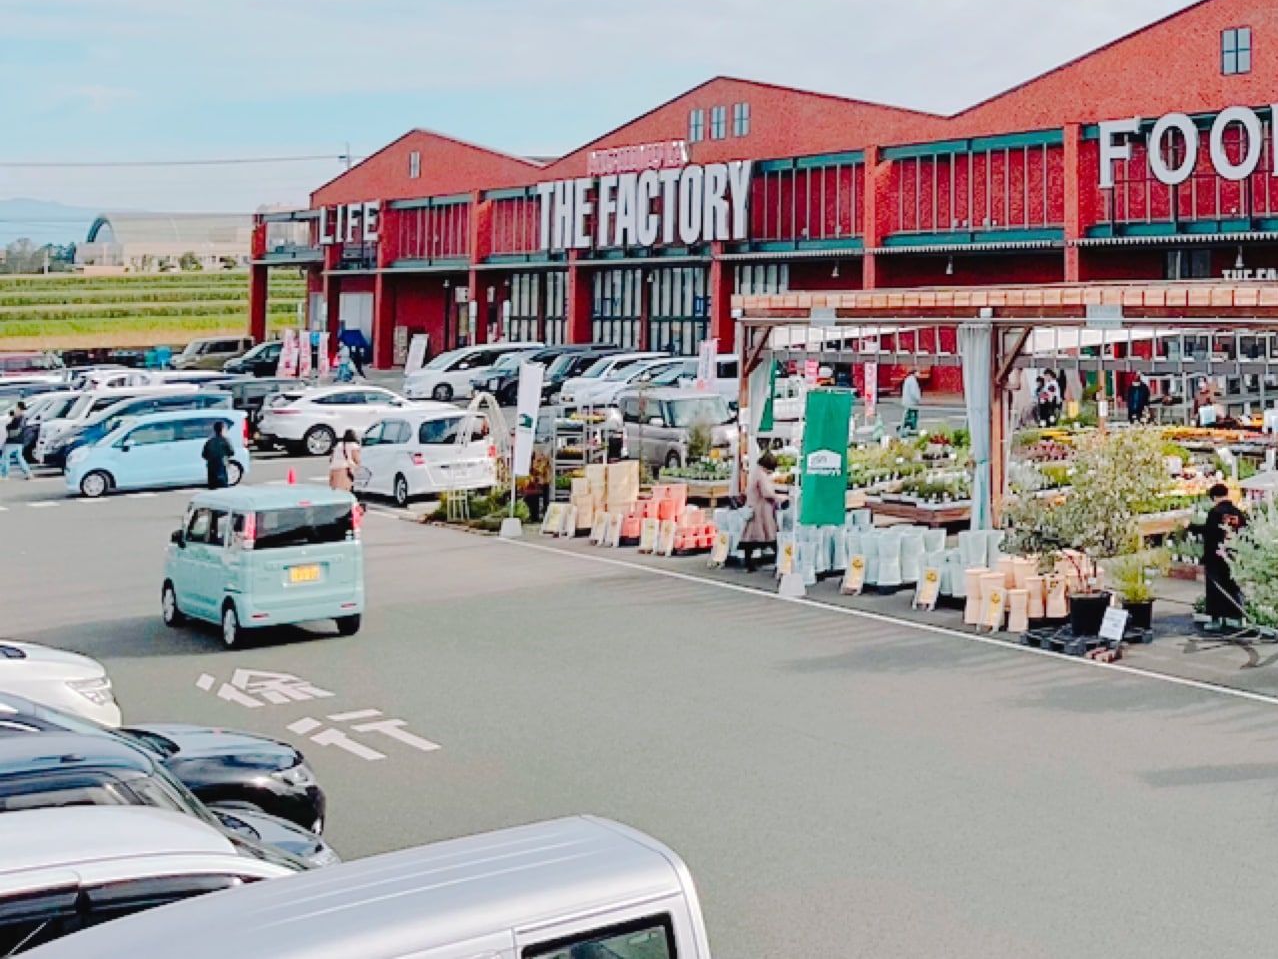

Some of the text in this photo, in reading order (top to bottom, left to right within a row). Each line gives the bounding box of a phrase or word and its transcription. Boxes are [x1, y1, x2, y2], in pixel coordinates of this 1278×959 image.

[319, 199, 380, 244] LIFE
[537, 159, 753, 249] THE FACTORY
